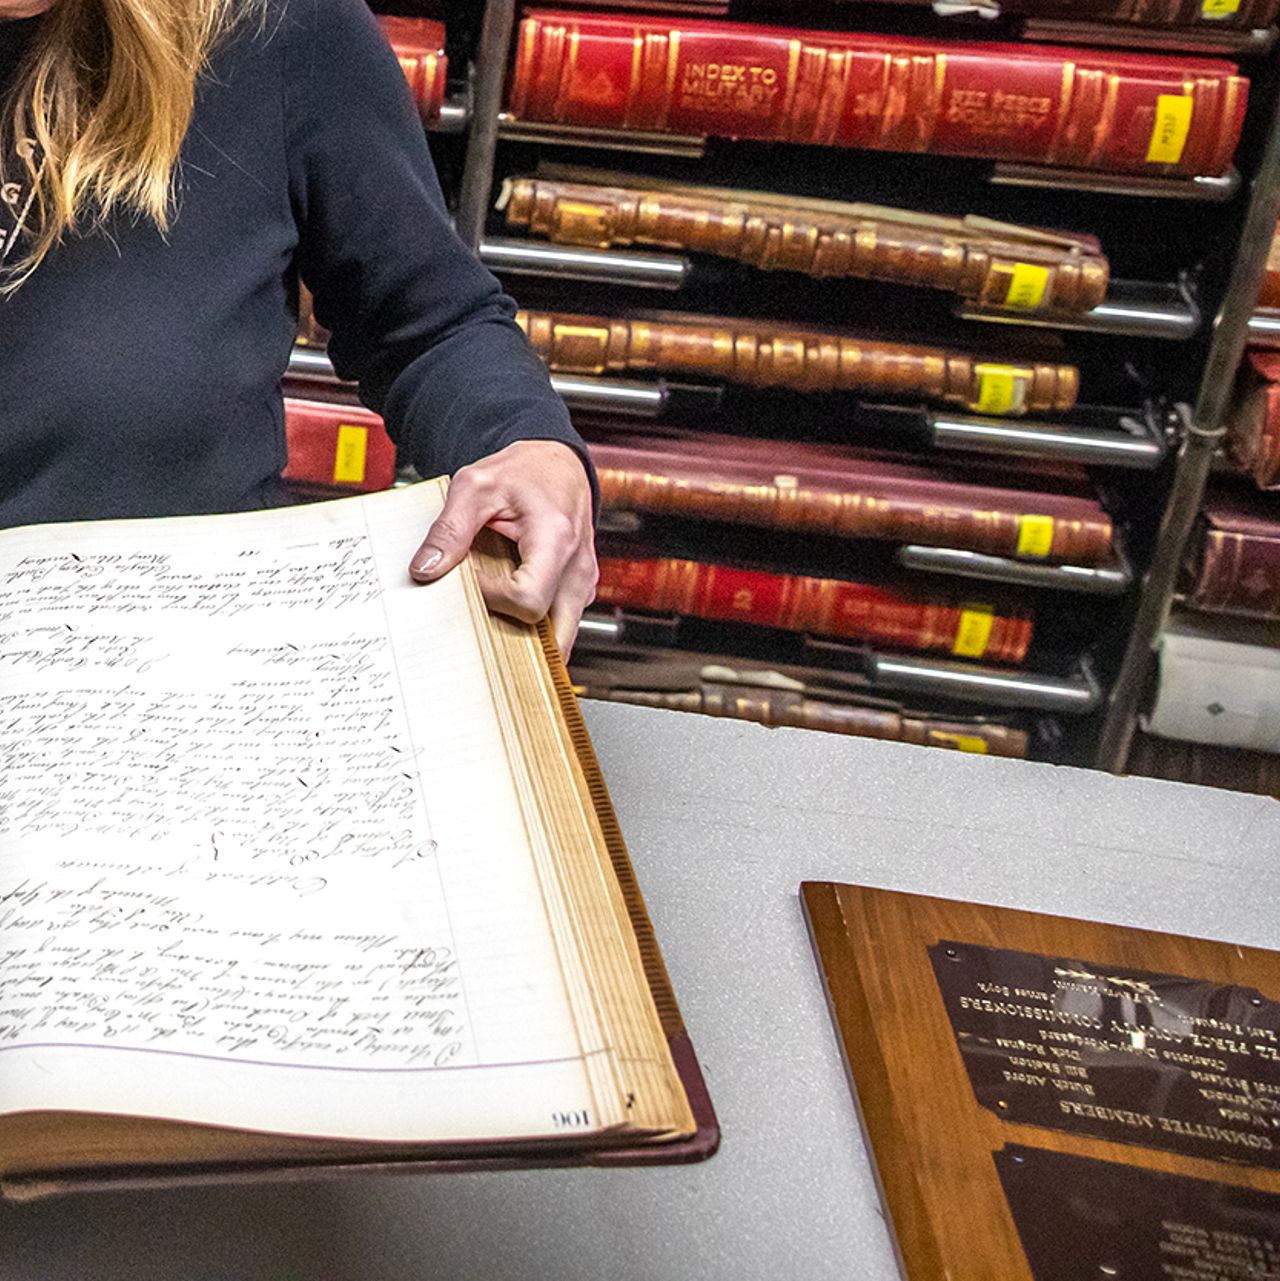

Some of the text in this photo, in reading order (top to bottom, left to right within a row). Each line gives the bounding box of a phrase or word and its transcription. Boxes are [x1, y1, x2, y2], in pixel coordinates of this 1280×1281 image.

[685, 63, 778, 85] INDEX TO
[682, 78, 779, 104] MILITARY
[0, 182, 22, 205] G
[959, 995, 1101, 1030] COMMISSIONERS
[550, 1109, 591, 1130] 106
[1060, 1100, 1272, 1150] COMMITTEE MEMBERS
